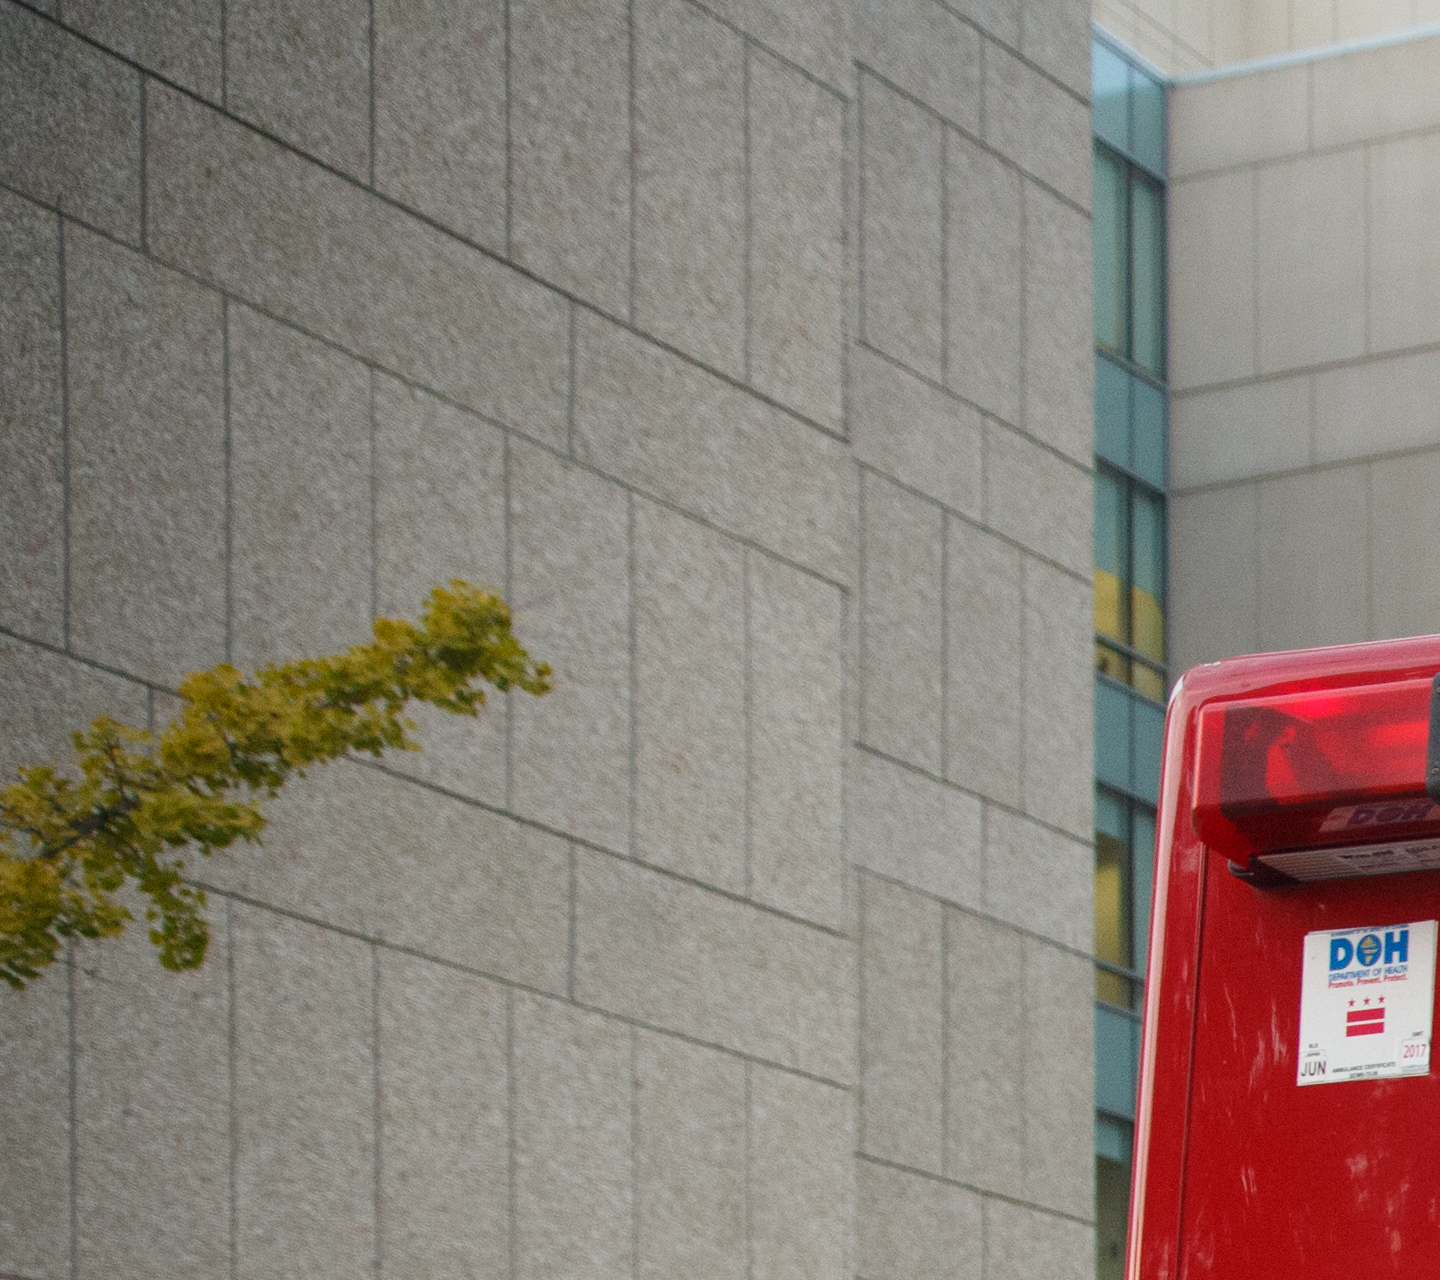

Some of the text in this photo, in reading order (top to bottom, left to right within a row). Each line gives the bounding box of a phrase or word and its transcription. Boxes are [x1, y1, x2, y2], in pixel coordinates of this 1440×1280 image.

[1329, 929, 1409, 971] DOH
[1403, 1044, 1426, 1059] 2017
[1300, 1061, 1327, 1077] JUN
